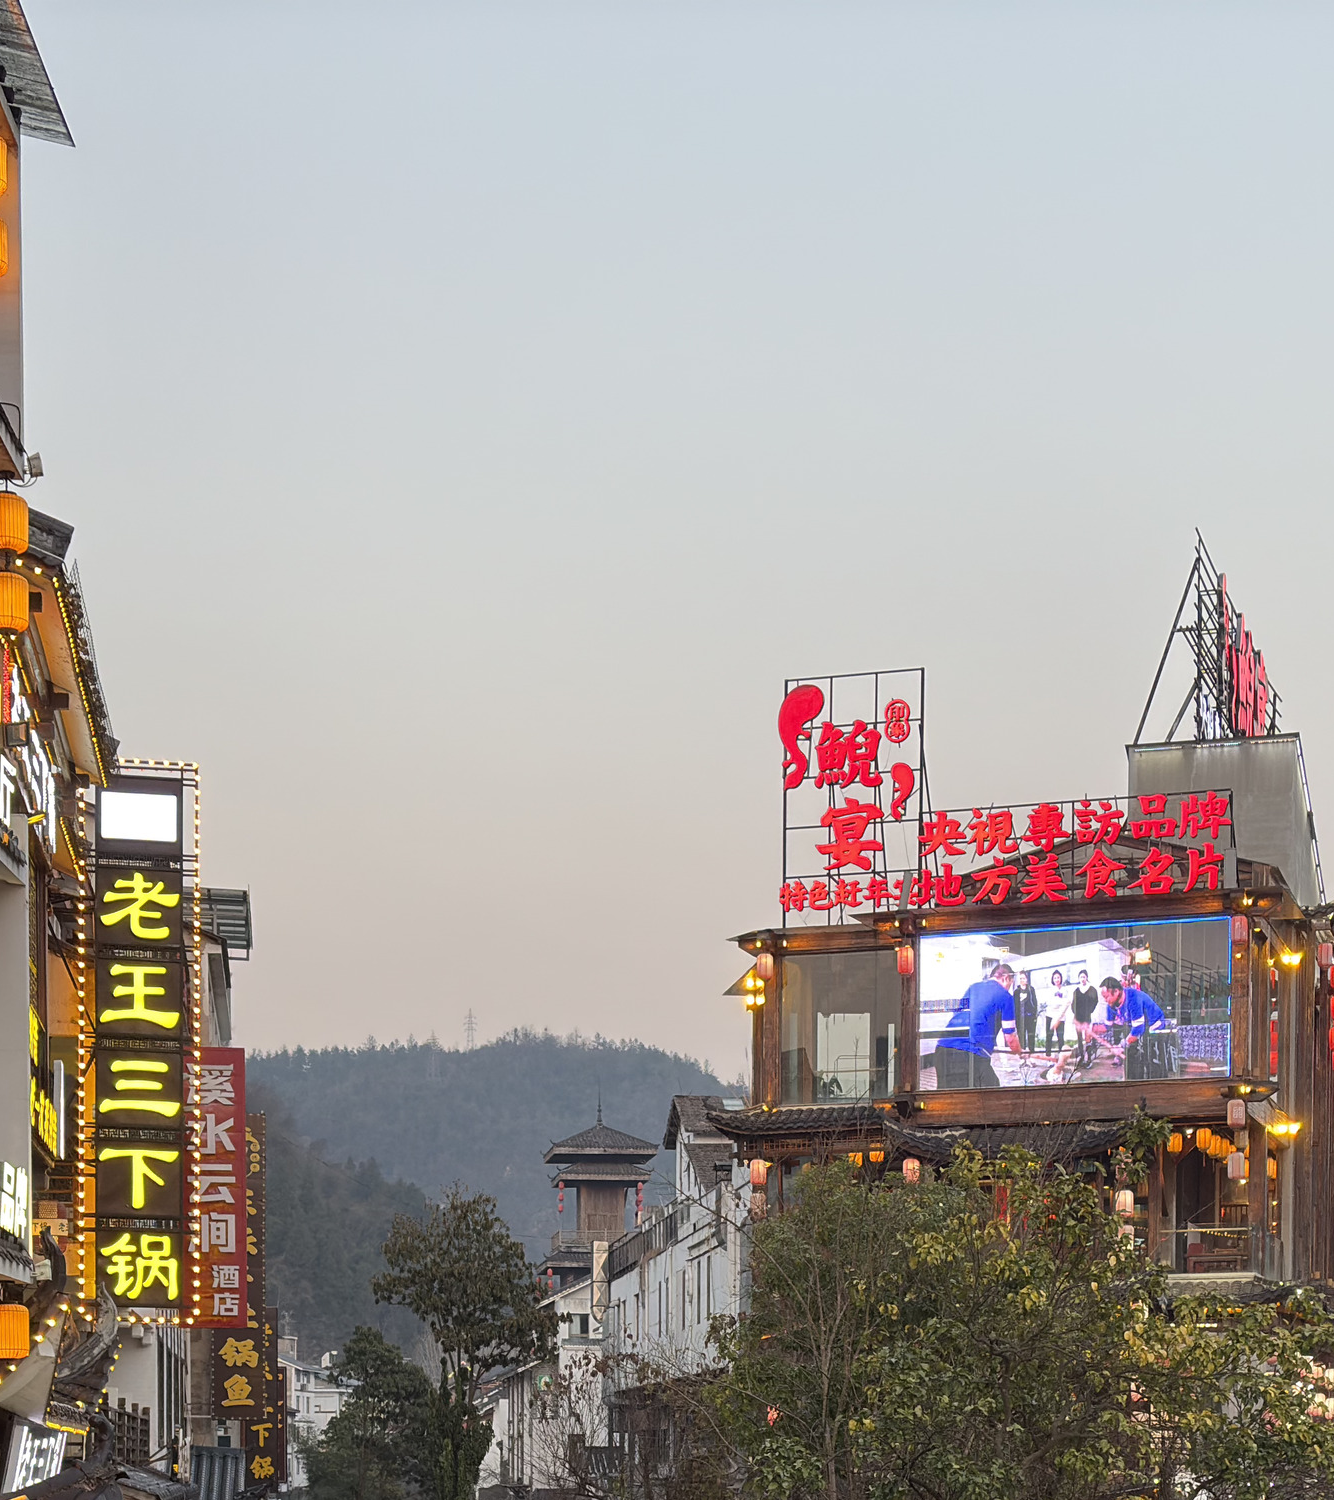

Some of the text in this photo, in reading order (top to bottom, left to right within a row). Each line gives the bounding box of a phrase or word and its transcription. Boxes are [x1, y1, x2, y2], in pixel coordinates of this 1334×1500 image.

[917, 841, 1226, 907] 地方美食名片
[98, 871, 181, 1301] 老王三下锅
[211, 1264, 241, 1317] 酒店
